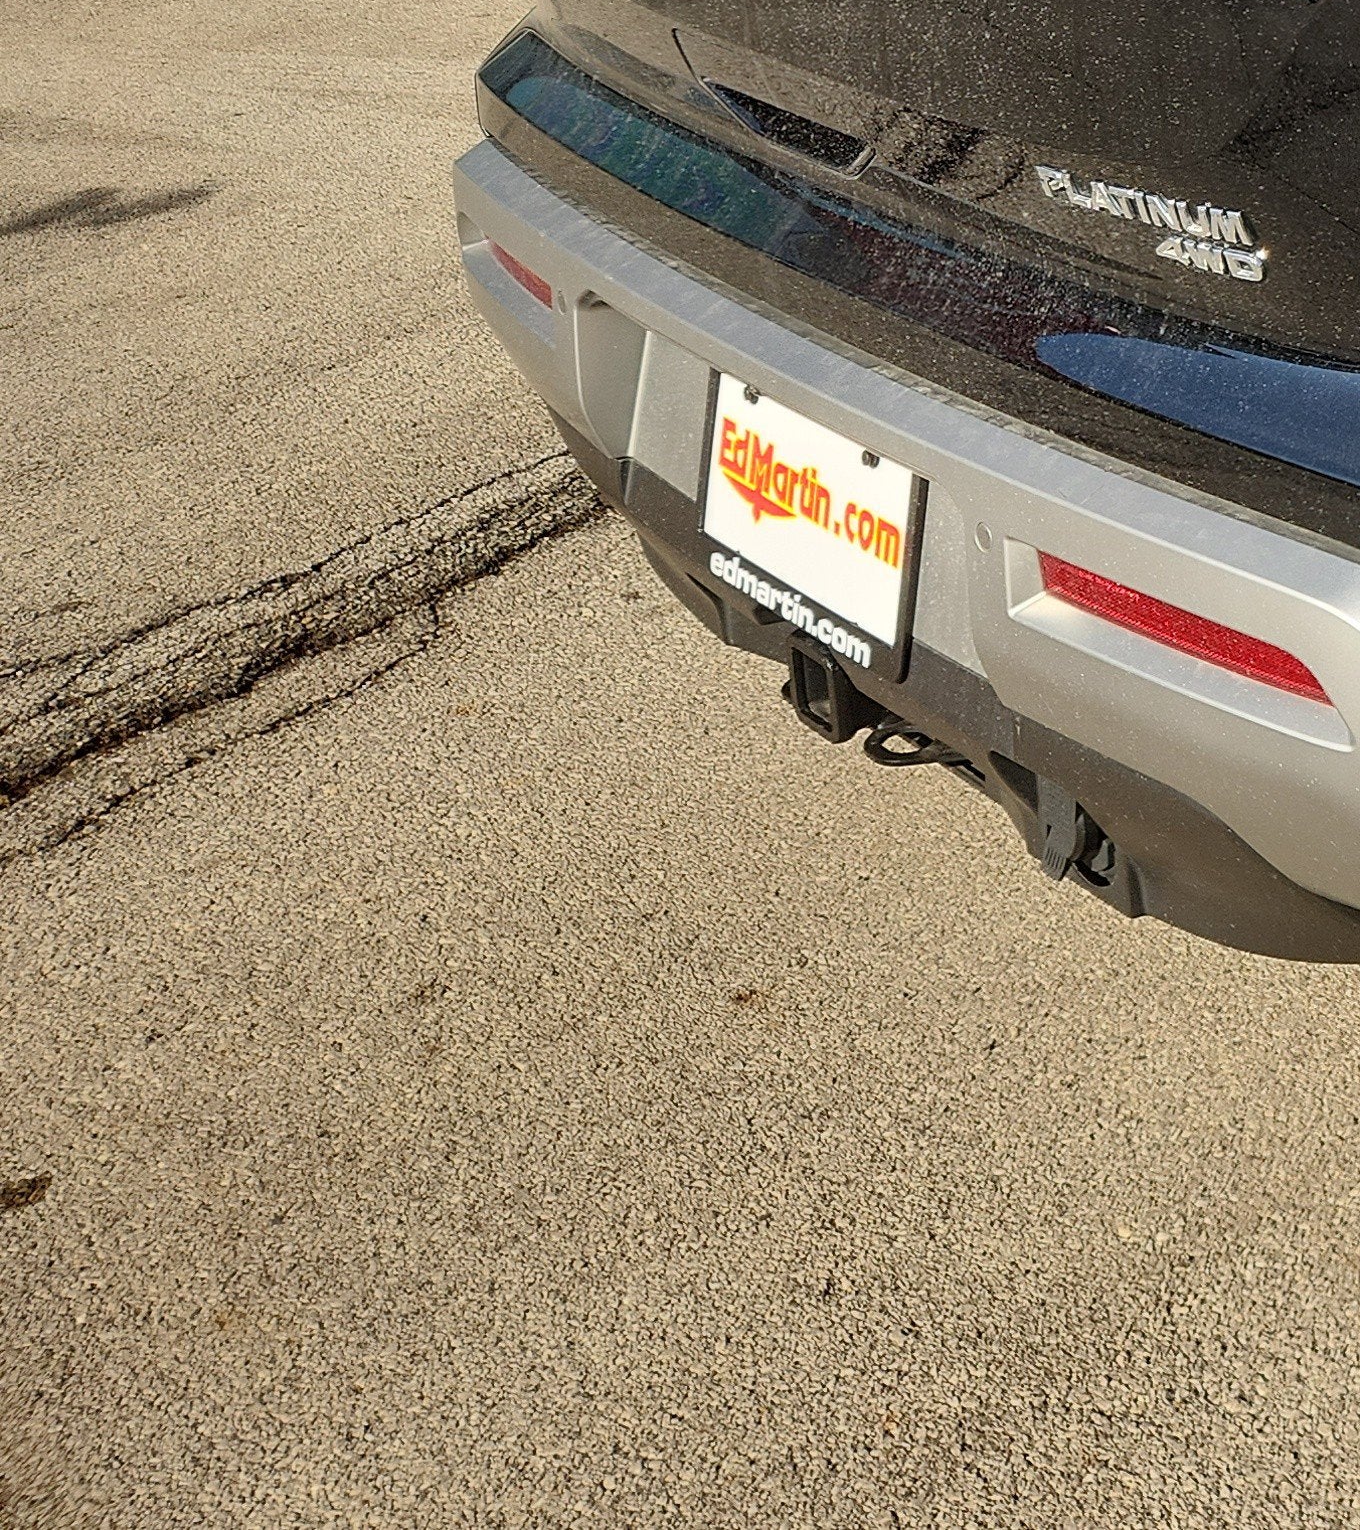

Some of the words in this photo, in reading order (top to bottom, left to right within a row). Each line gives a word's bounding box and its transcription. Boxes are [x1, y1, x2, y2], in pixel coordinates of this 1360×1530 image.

[1034, 165, 1253, 247] PLATINUM
[718, 415, 901, 569] EdMartin.com
[709, 550, 872, 669] edmartin.com
